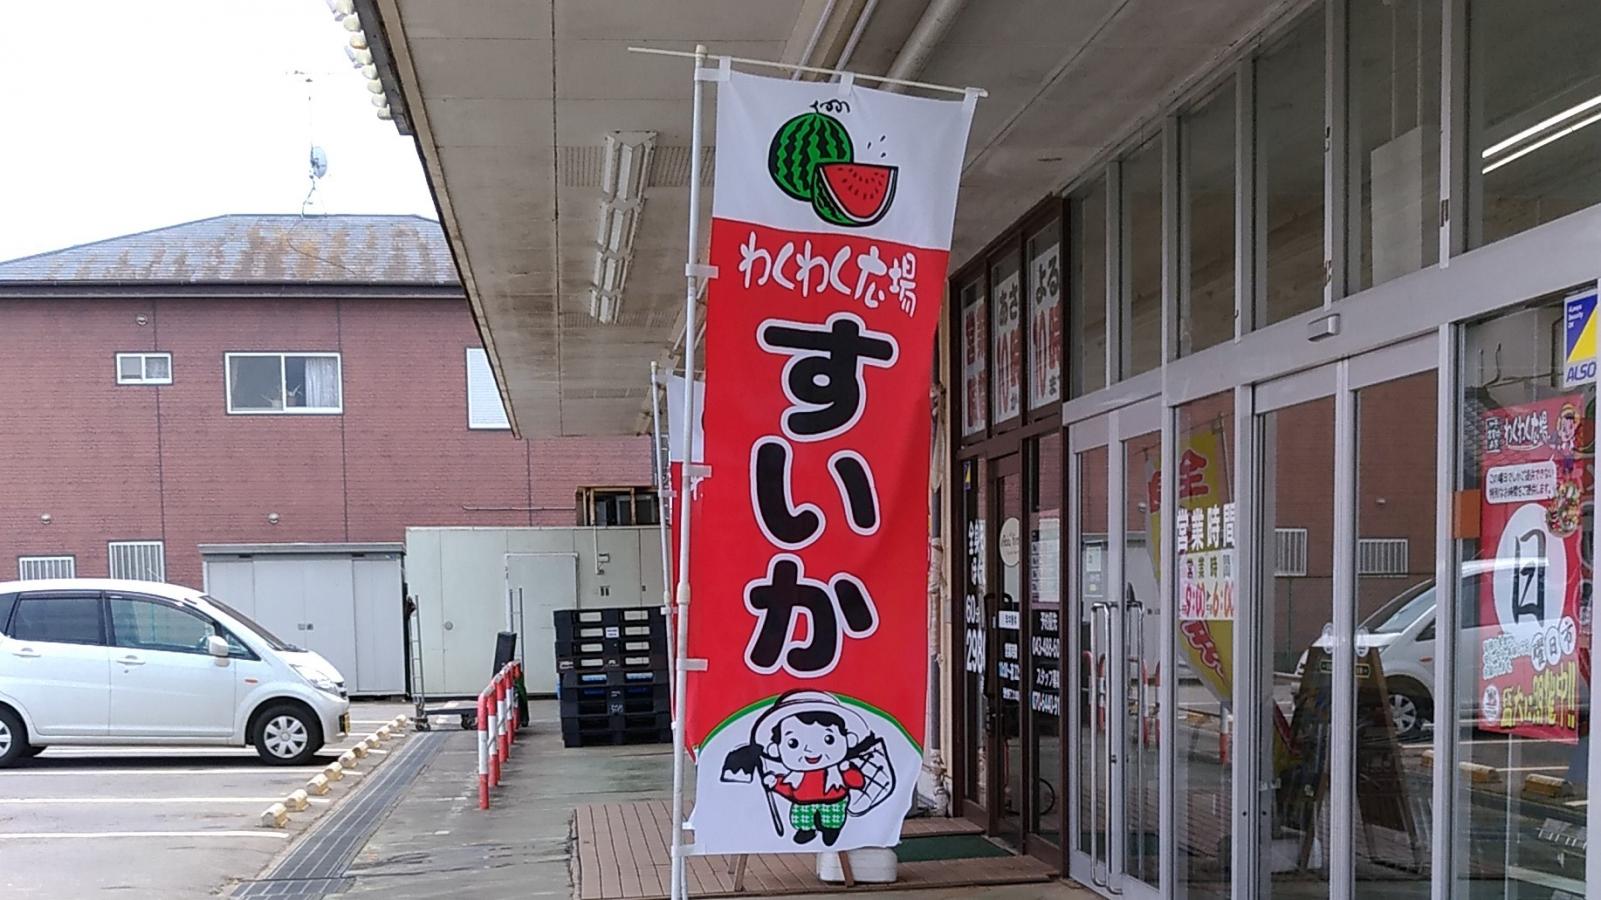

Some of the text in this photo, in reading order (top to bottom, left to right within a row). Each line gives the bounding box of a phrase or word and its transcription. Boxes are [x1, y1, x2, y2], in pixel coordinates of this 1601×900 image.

[738, 230, 918, 319] わくわく広場
[1036, 256, 1059, 305] よる
[999, 284, 1018, 326] あさ
[743, 309, 901, 679] すいか
[1177, 502, 1235, 553] 営業時間
